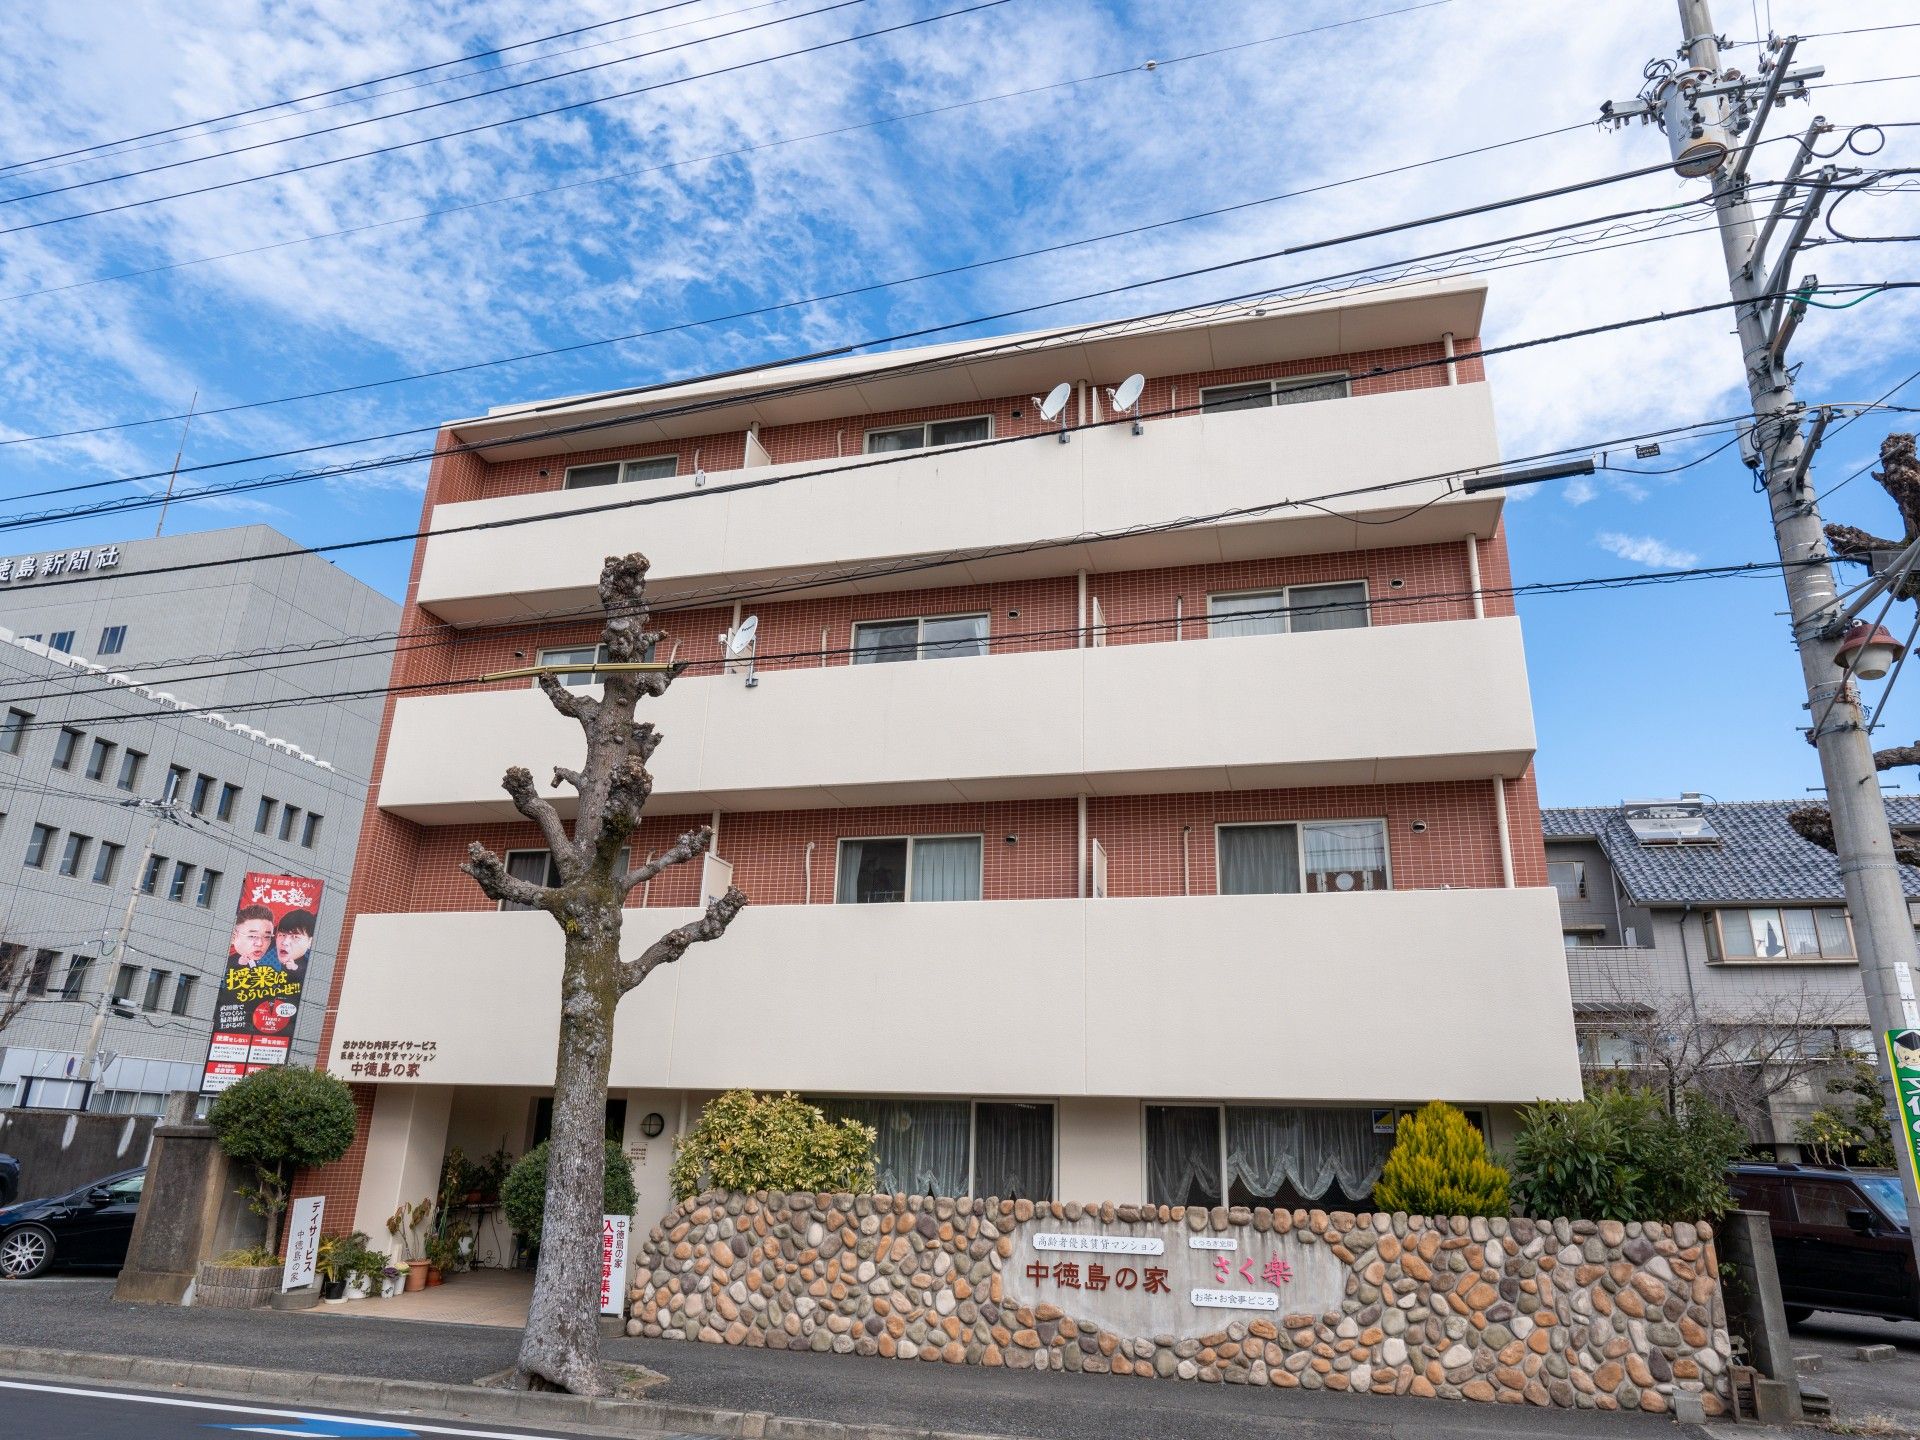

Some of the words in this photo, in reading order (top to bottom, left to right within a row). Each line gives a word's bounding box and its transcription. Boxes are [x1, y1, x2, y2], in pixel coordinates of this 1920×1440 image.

[226, 966, 288, 990] 授業は
[340, 1051, 437, 1061] 医療と介護の賃貸マンション
[342, 1040, 437, 1050] おかがわ内科デイサービス
[351, 1061, 420, 1078] 中徳島の家
[303, 1201, 321, 1273] デイサービス
[614, 1220, 626, 1269] 中徳島の家
[1038, 1236, 1160, 1251] 高齢者優良賃貸マンション
[290, 1230, 305, 1283] 中徳島の家
[1213, 1249, 1294, 1288] さく楽
[1025, 1259, 1172, 1295] 中徳島の家
[1195, 1293, 1275, 1306] お茶・お食事どころ
